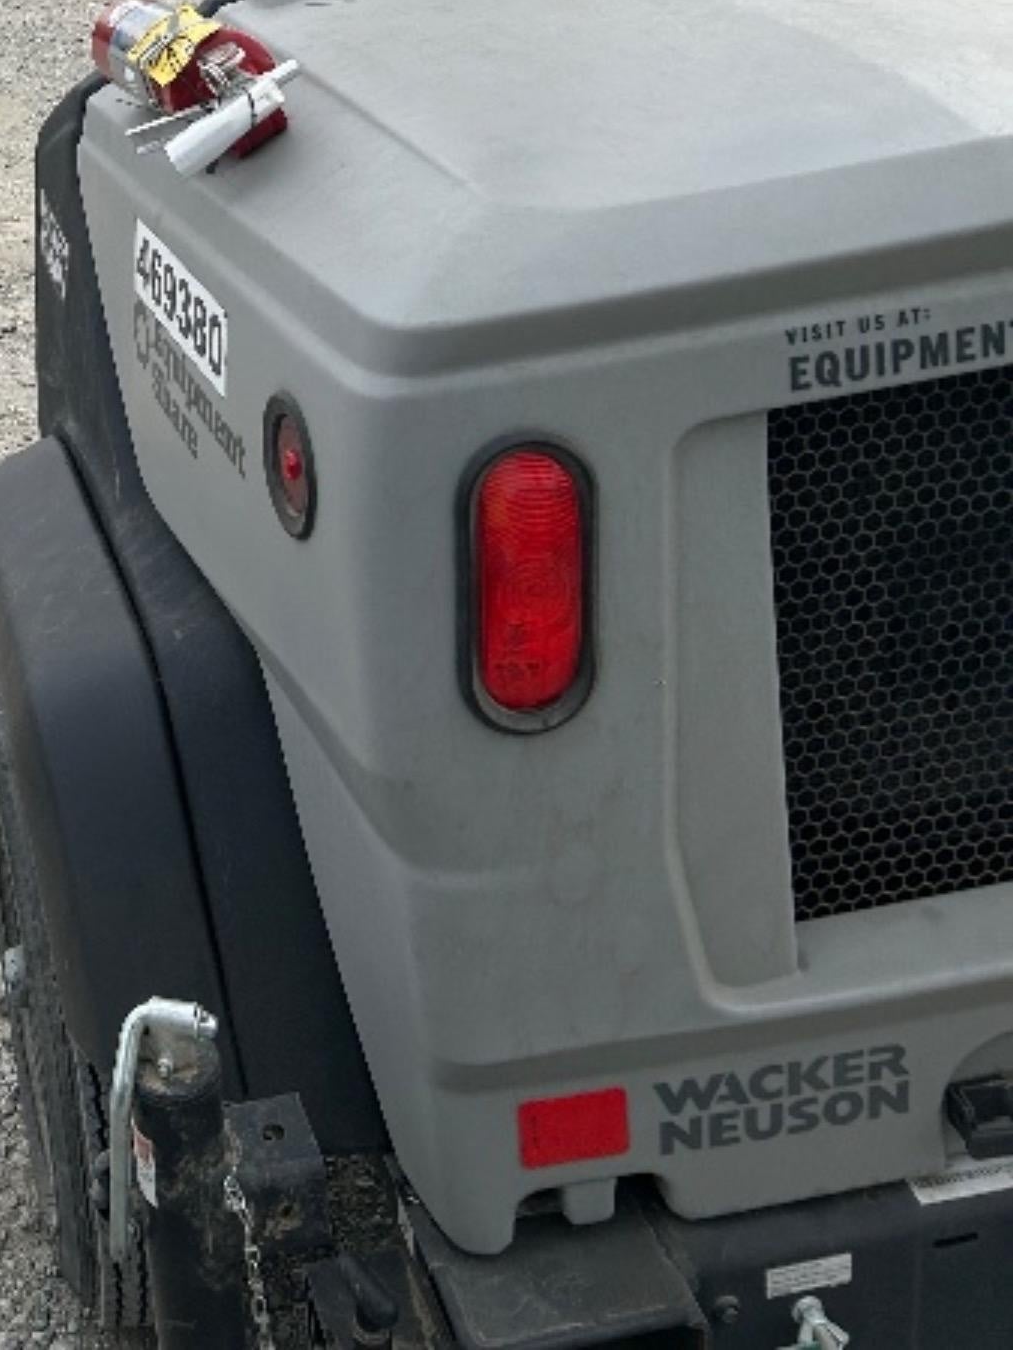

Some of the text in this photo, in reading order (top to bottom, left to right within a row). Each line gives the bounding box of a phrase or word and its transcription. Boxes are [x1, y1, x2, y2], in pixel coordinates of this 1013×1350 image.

[137, 237, 223, 376] 469380
[785, 307, 931, 346] VISIT US AT:
[789, 319, 1013, 392] EQUIPMEN
[653, 1043, 909, 1117] WACKER
[659, 1080, 909, 1155] NEUSON
